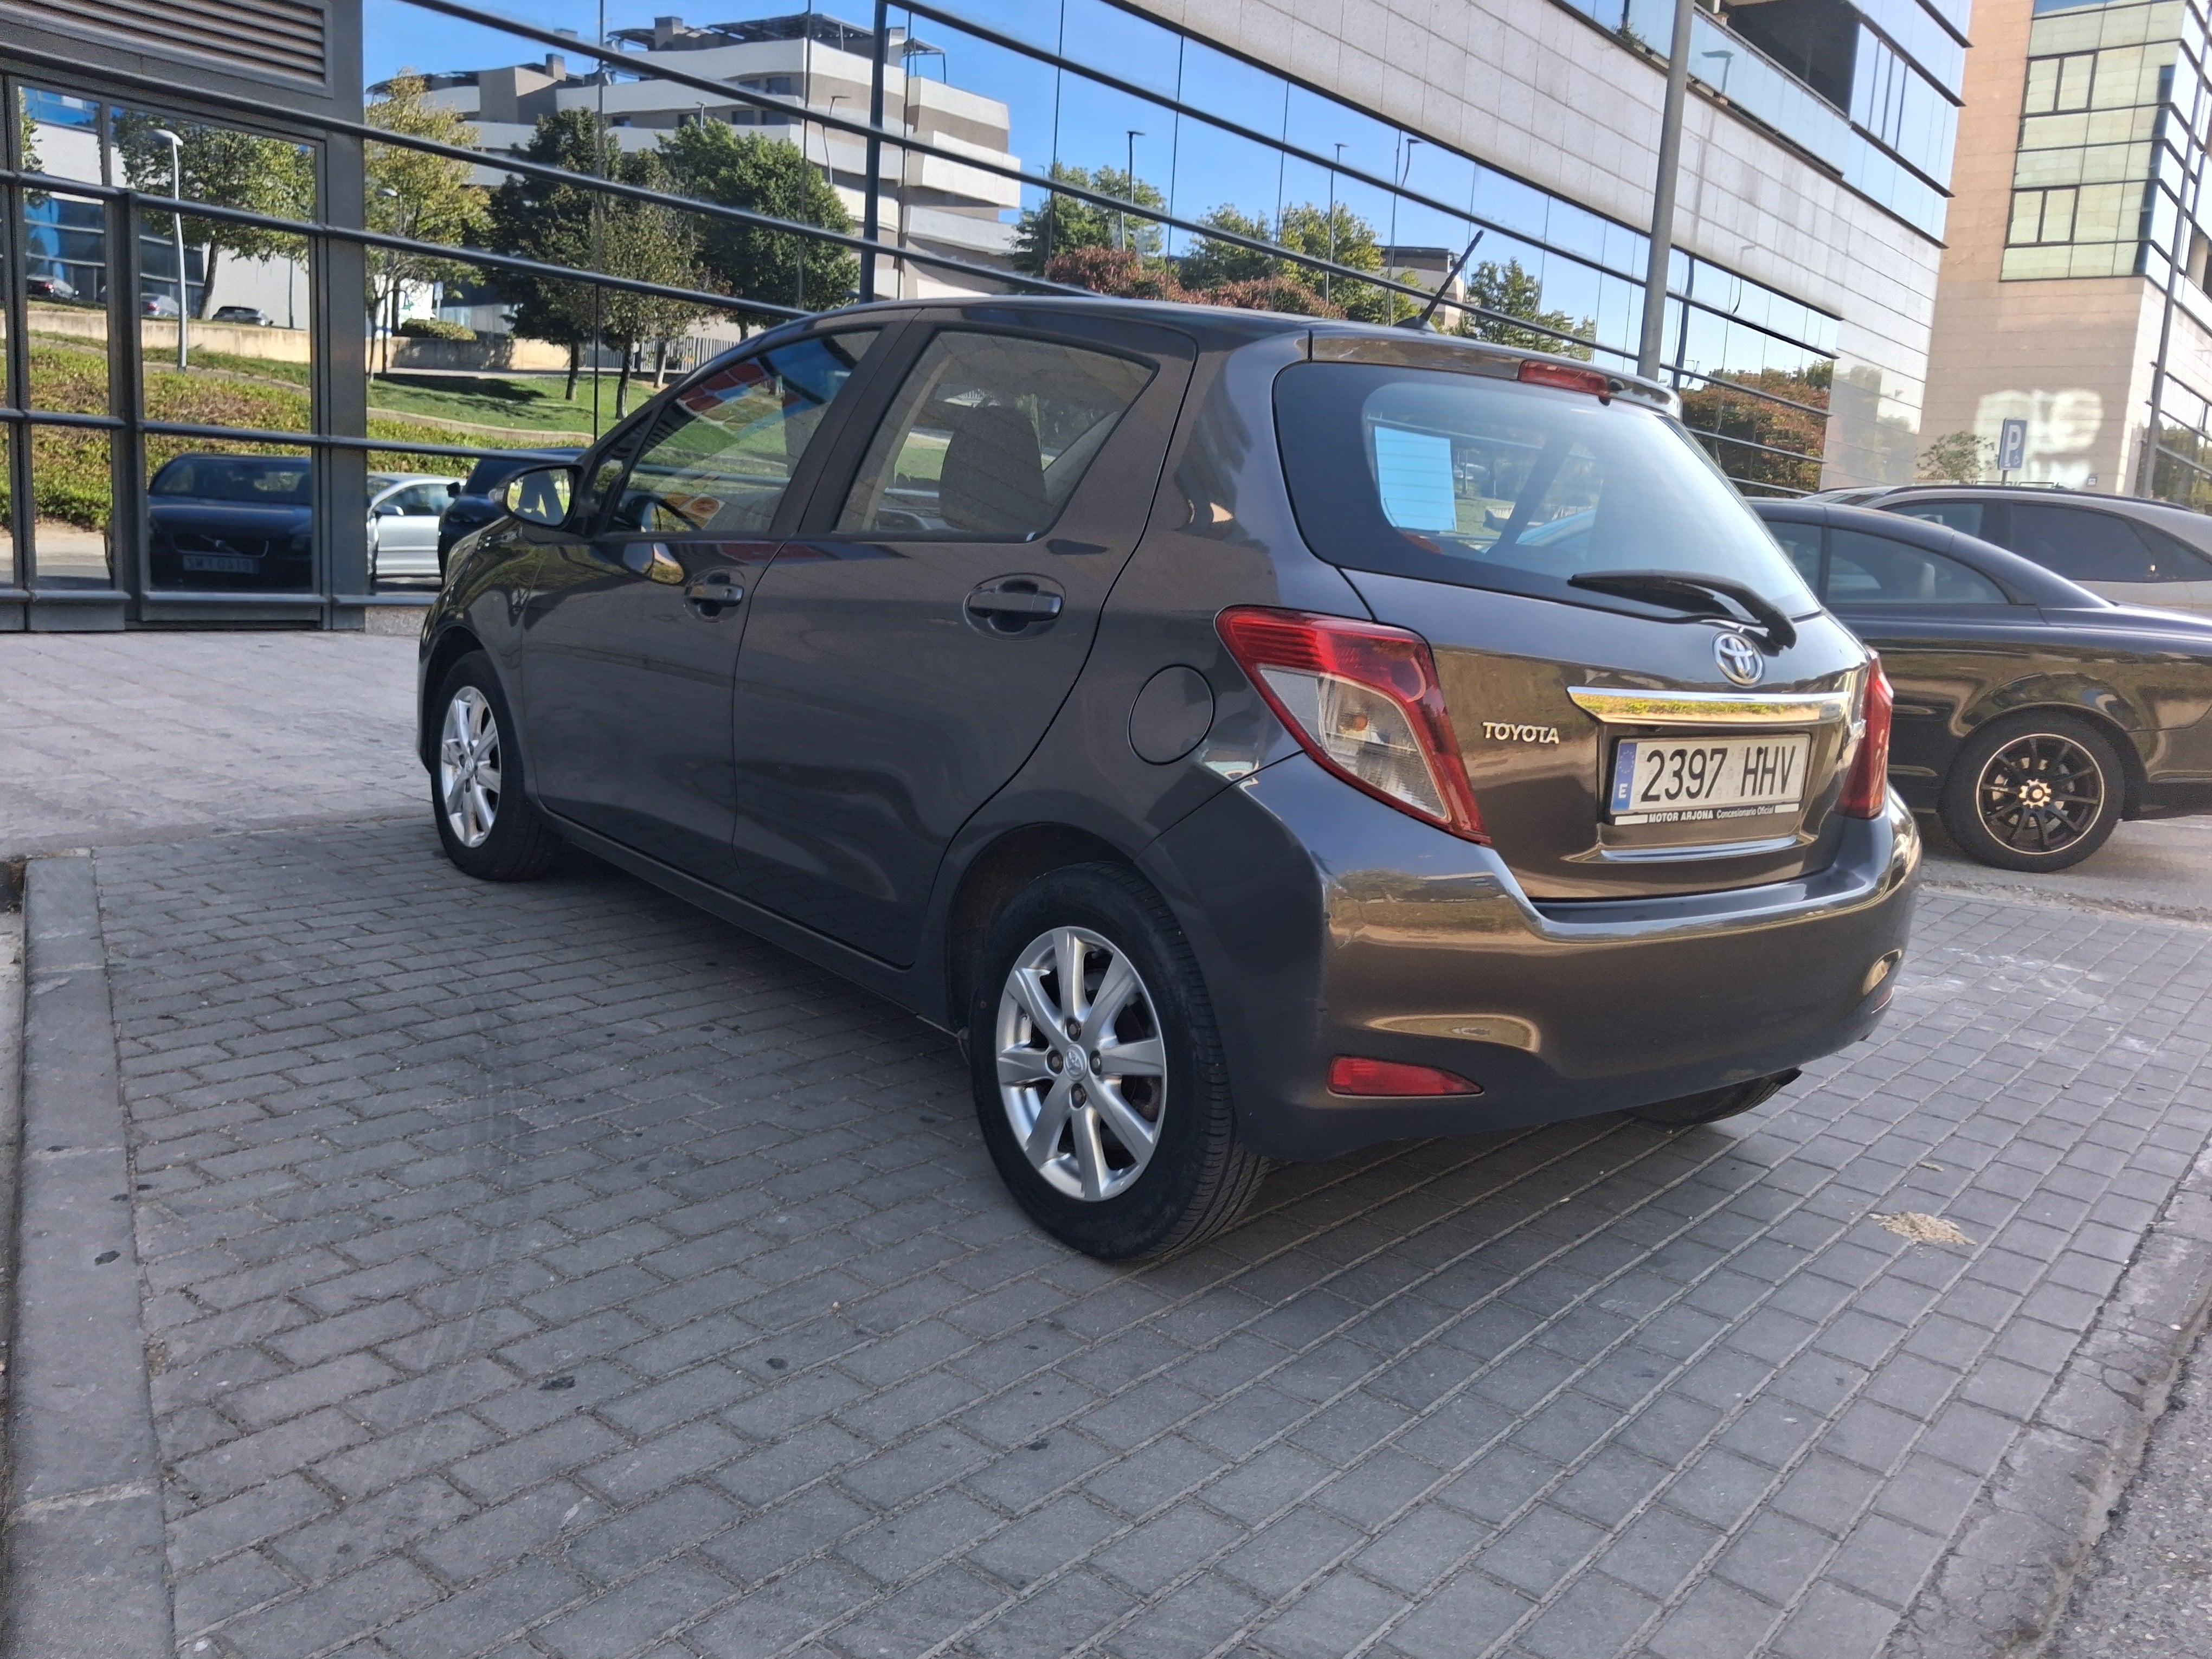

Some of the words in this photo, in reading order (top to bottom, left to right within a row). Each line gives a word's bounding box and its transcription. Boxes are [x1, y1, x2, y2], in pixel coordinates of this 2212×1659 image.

[2005, 425, 2022, 465] P
[1482, 722, 1560, 744] TOYOTA
[1641, 747, 1728, 802] 2397
[1740, 745, 1797, 797] HHV
[1618, 783, 1628, 799] E
[1649, 811, 1679, 823] MOTOR
[1680, 811, 1714, 821] ARJONA
[1716, 808, 1756, 820] Concesionario
[1757, 806, 1774, 815] Oficial
